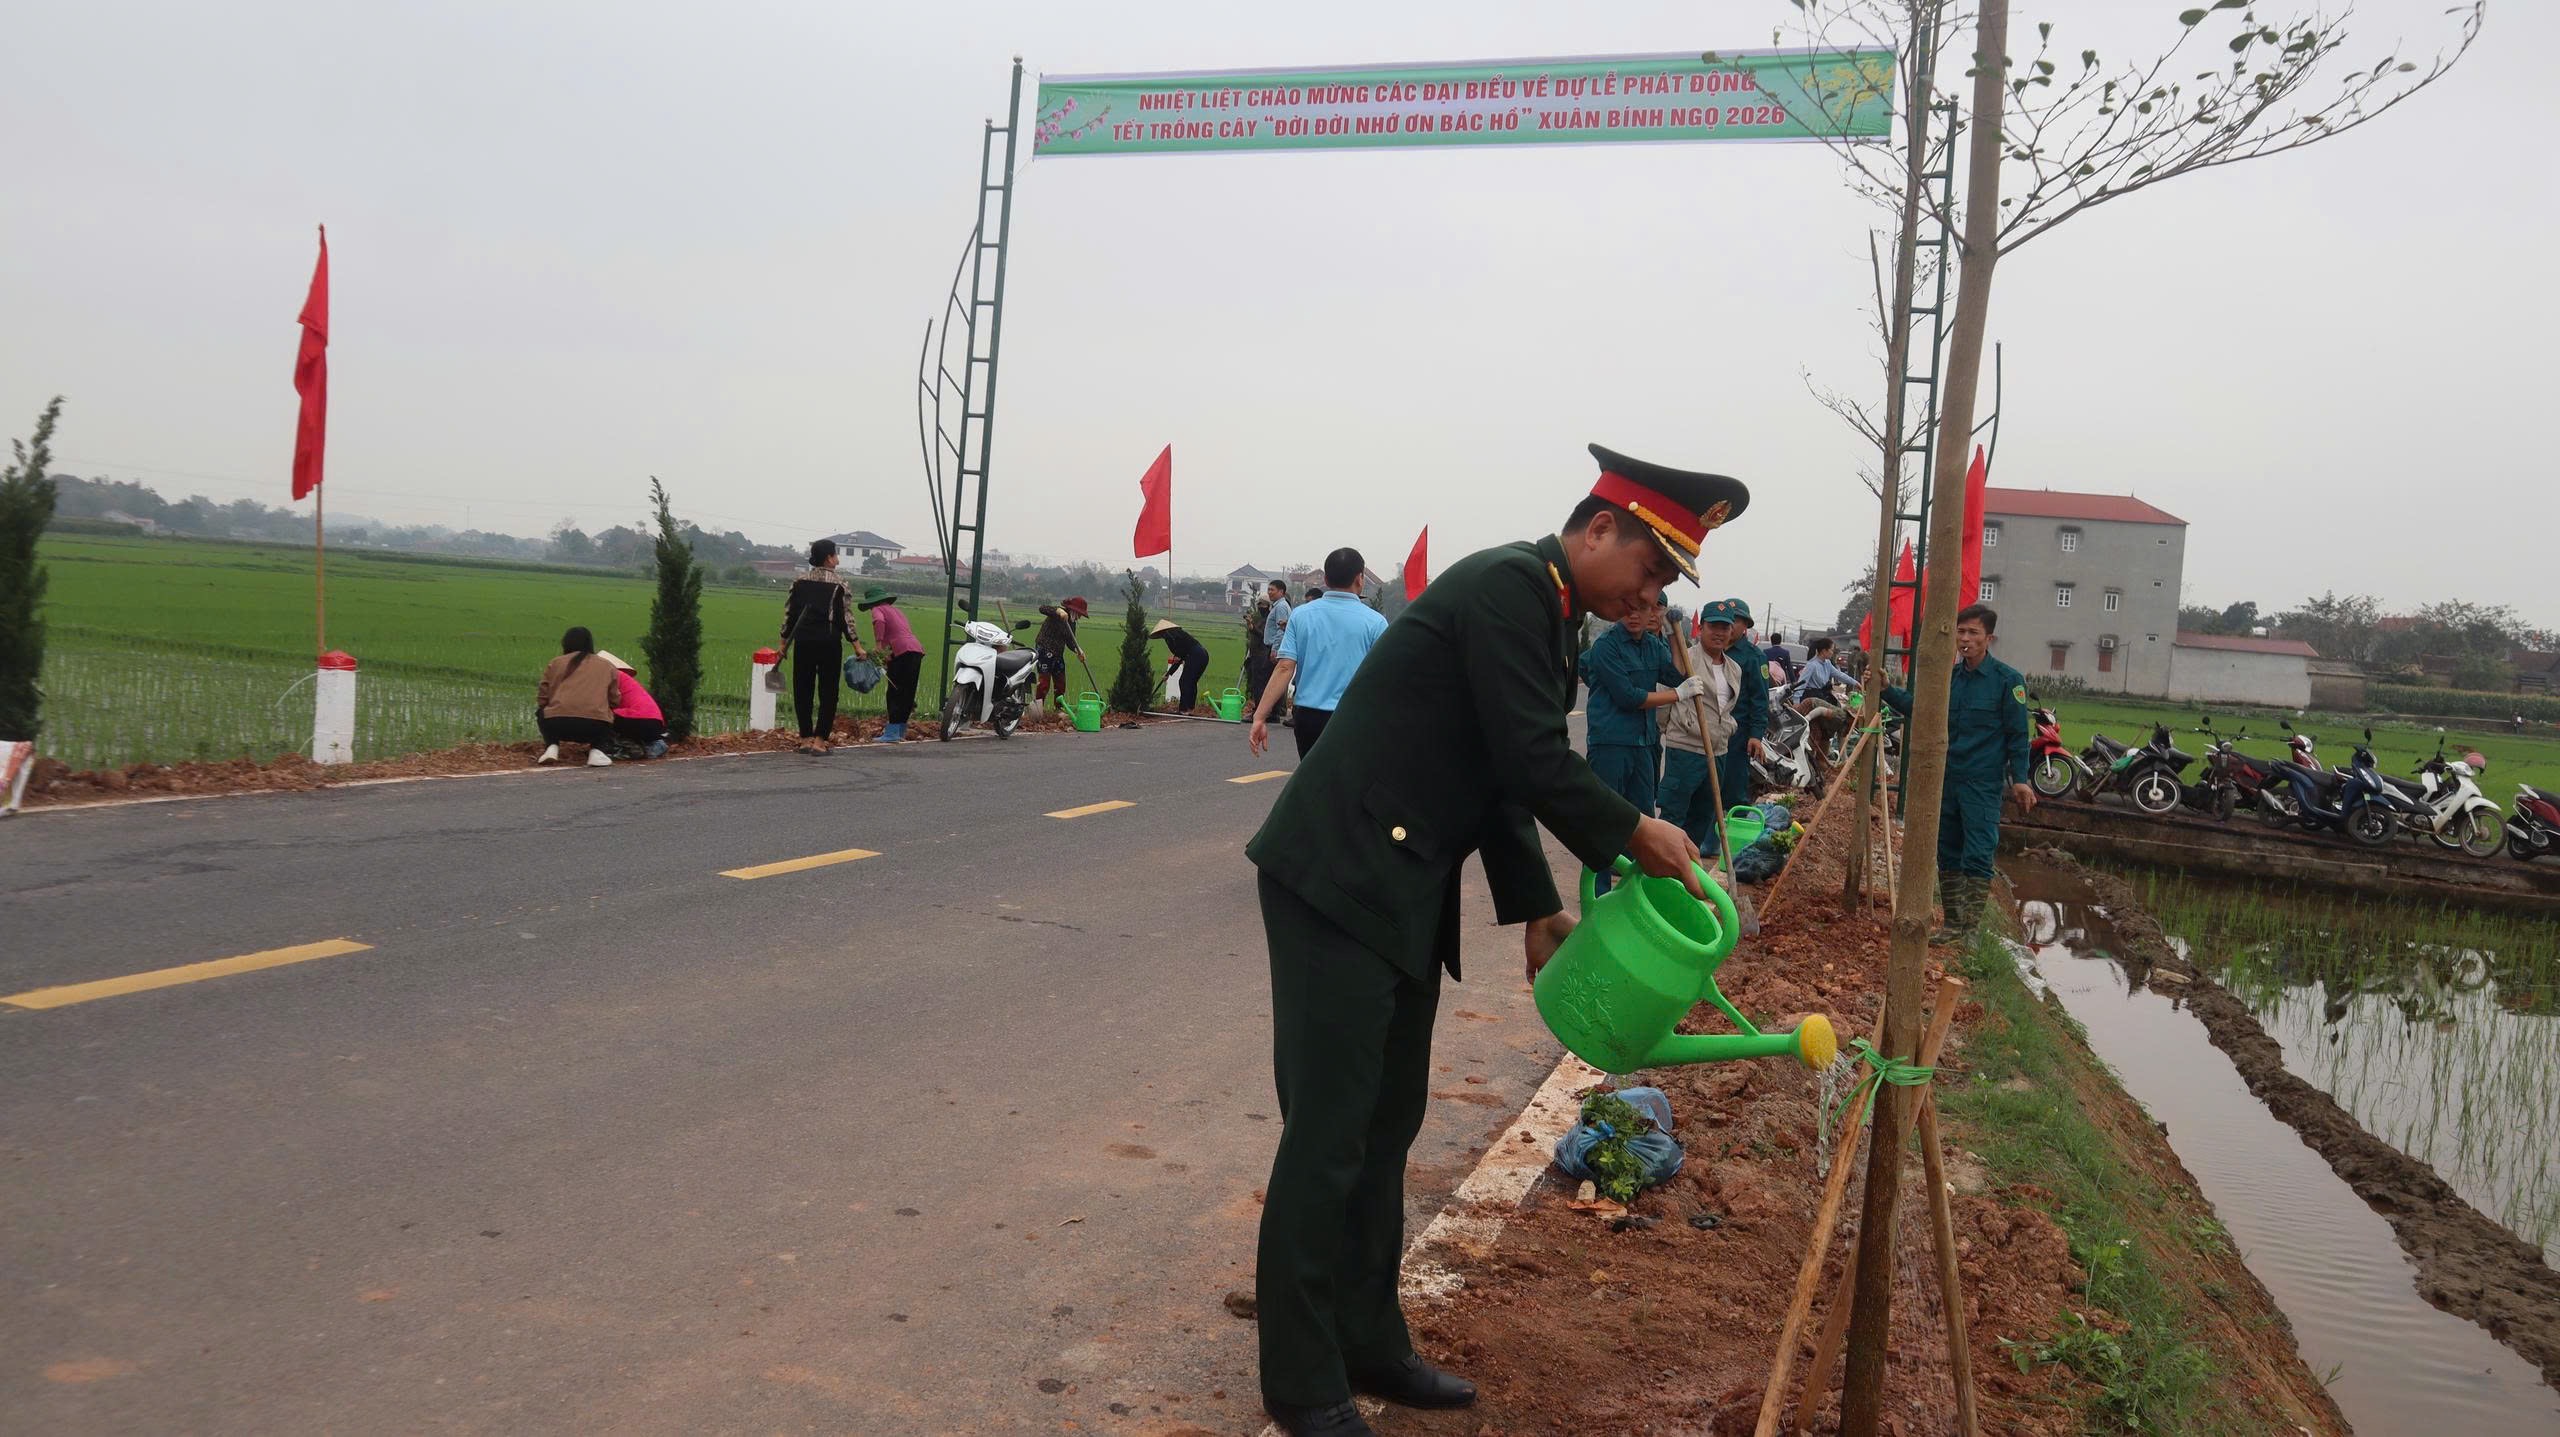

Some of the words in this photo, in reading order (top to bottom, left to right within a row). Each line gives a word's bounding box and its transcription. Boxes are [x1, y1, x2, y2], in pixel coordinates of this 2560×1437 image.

[1139, 89, 1197, 113] NHIỆT
[1200, 88, 1243, 111] LIỆT
[1247, 86, 1302, 107] CHÀO
[1307, 83, 1369, 105] MỪNG
[1375, 81, 1418, 102] CÁC
[1423, 82, 1460, 104] ĐẠI
[1465, 73, 1516, 100] BIỂU
[1523, 74, 1550, 98] VỀ
[1555, 77, 1588, 100] DỰ
[1591, 71, 1617, 96] LỄ
[1623, 72, 1684, 95] PHÁT
[1689, 70, 1756, 96] ĐỘNG
[1113, 118, 1145, 141] TẾT
[1150, 117, 1214, 139] TRỒNG
[1219, 117, 1258, 138] CÂY
[1314, 114, 1350, 136] ĐỜI
[1356, 112, 1400, 134] NHỚ
[1405, 113, 1434, 133] ƠN
[1440, 110, 1483, 132] BÁC
[1538, 107, 1601, 130] XUÂN
[1607, 106, 1664, 128] BÍNH
[1670, 107, 1720, 130] NGỌ
[1726, 105, 1785, 126] 2026
